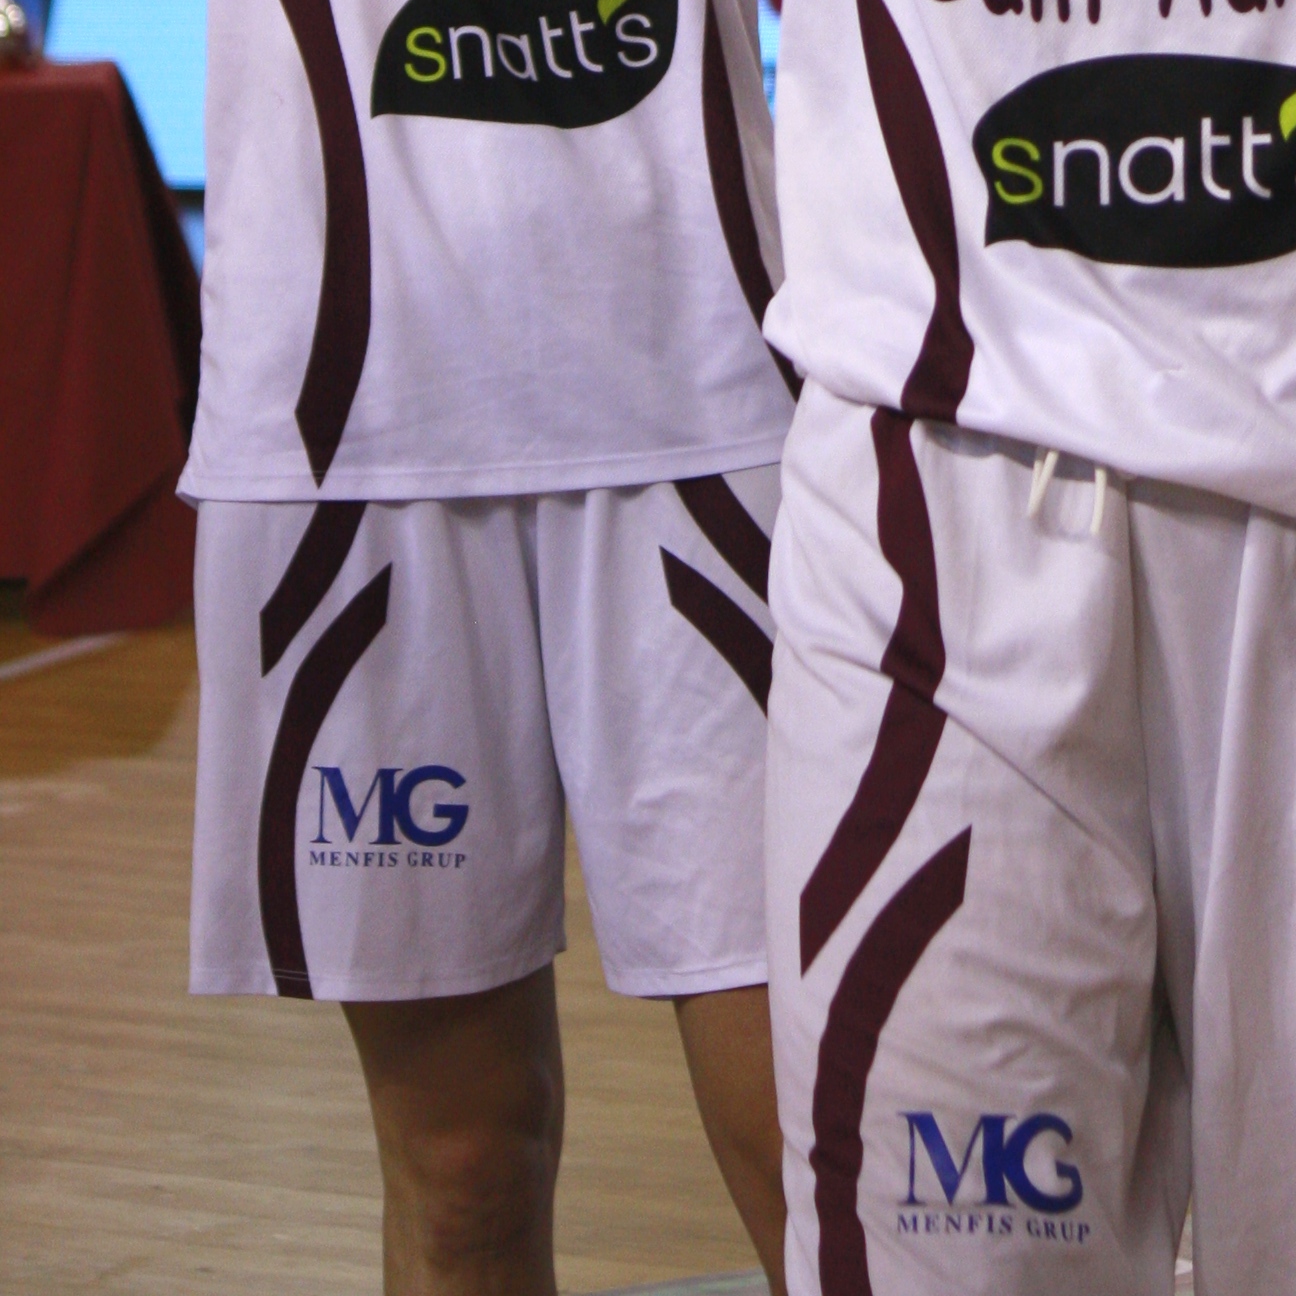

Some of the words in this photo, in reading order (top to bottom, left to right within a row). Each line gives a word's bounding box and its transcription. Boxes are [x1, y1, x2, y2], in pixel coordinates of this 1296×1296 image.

[311, 764, 470, 848] MG
[309, 850, 399, 868] MENFIS
[406, 851, 468, 870] GRUP
[896, 1111, 1085, 1215] MG
[897, 1213, 1014, 1236] MENFIS
[1026, 1217, 1092, 1245] GRUP
